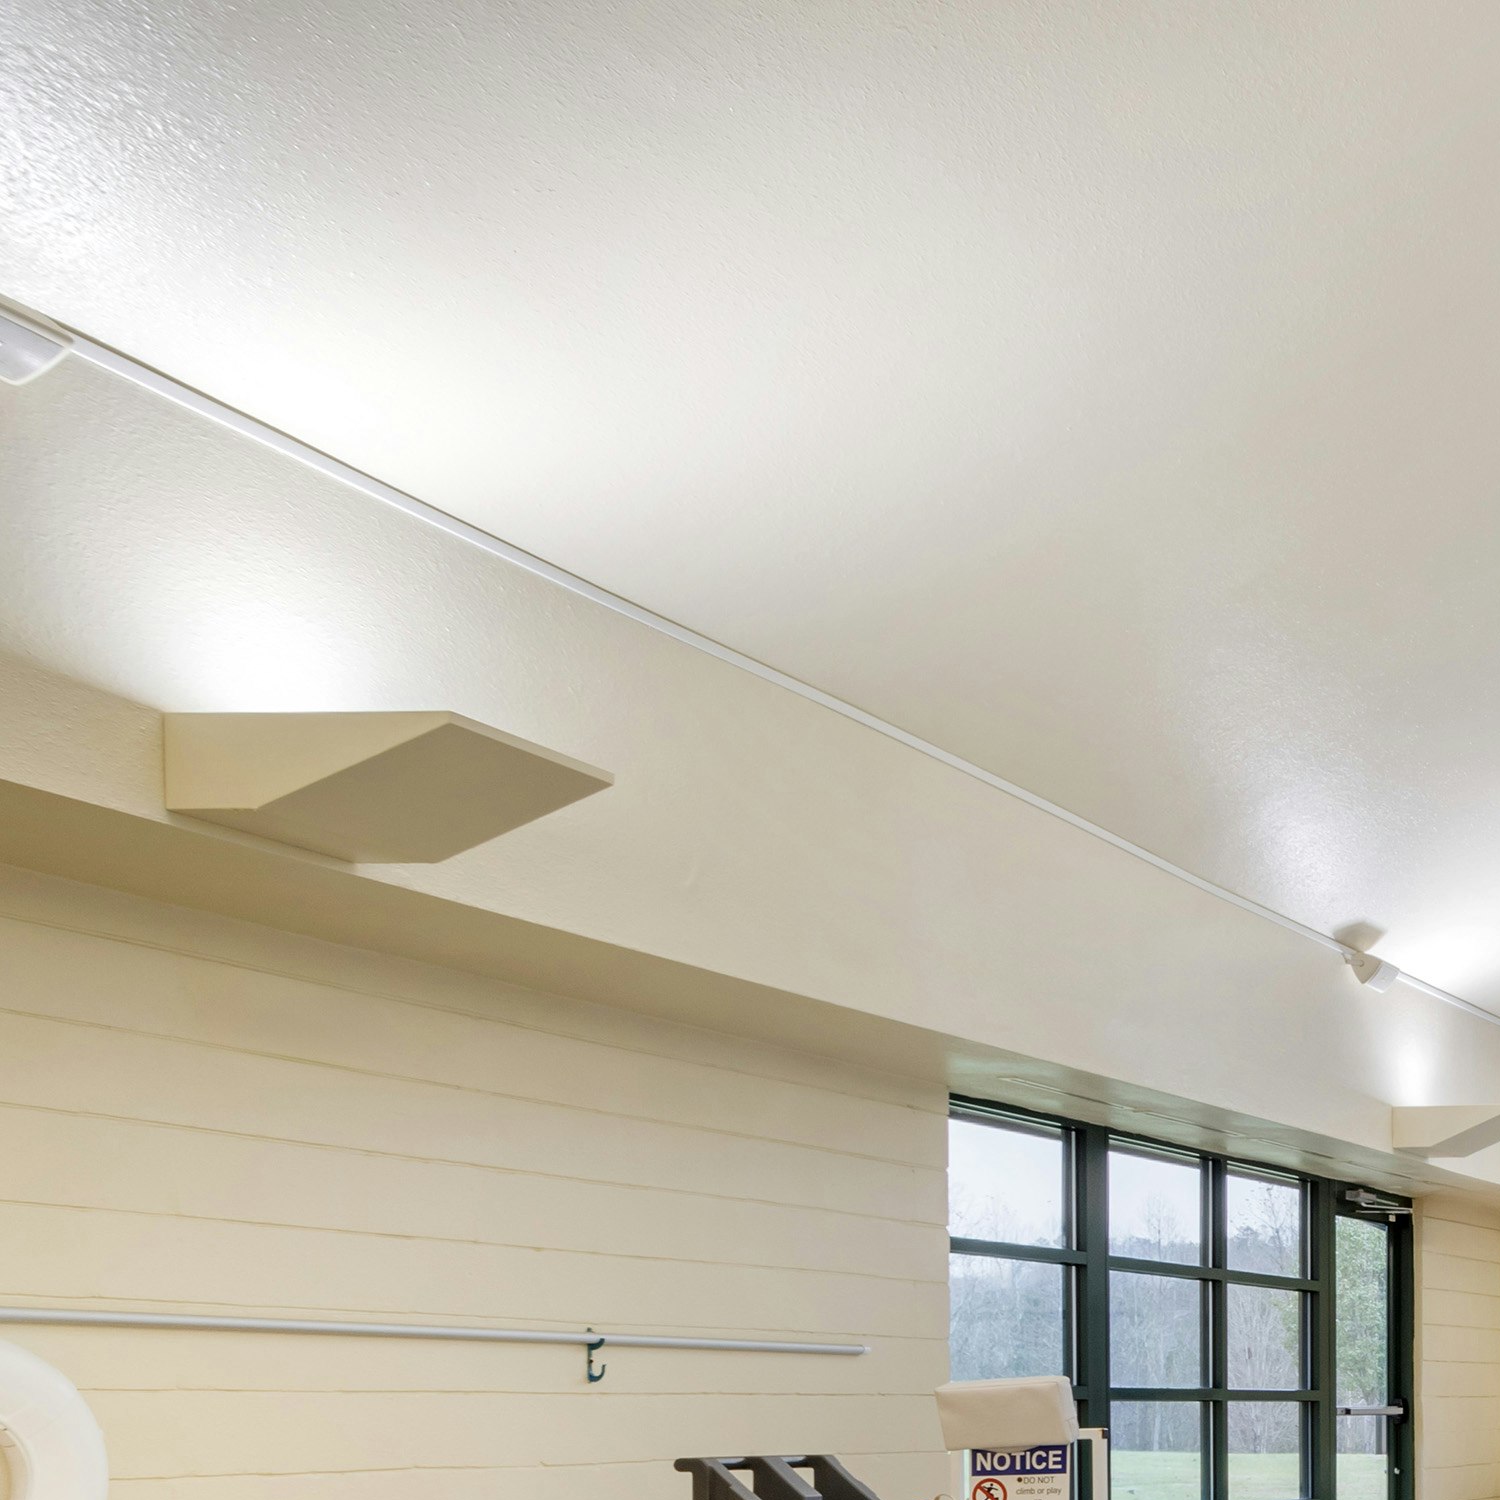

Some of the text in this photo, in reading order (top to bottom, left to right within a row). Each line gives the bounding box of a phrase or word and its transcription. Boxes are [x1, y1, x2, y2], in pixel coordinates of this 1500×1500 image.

[976, 1450, 1063, 1471] NOTICE
[1023, 1475, 1055, 1485] DO NOT
[1015, 1487, 1036, 1495] climb
[1046, 1487, 1062, 1496] play
